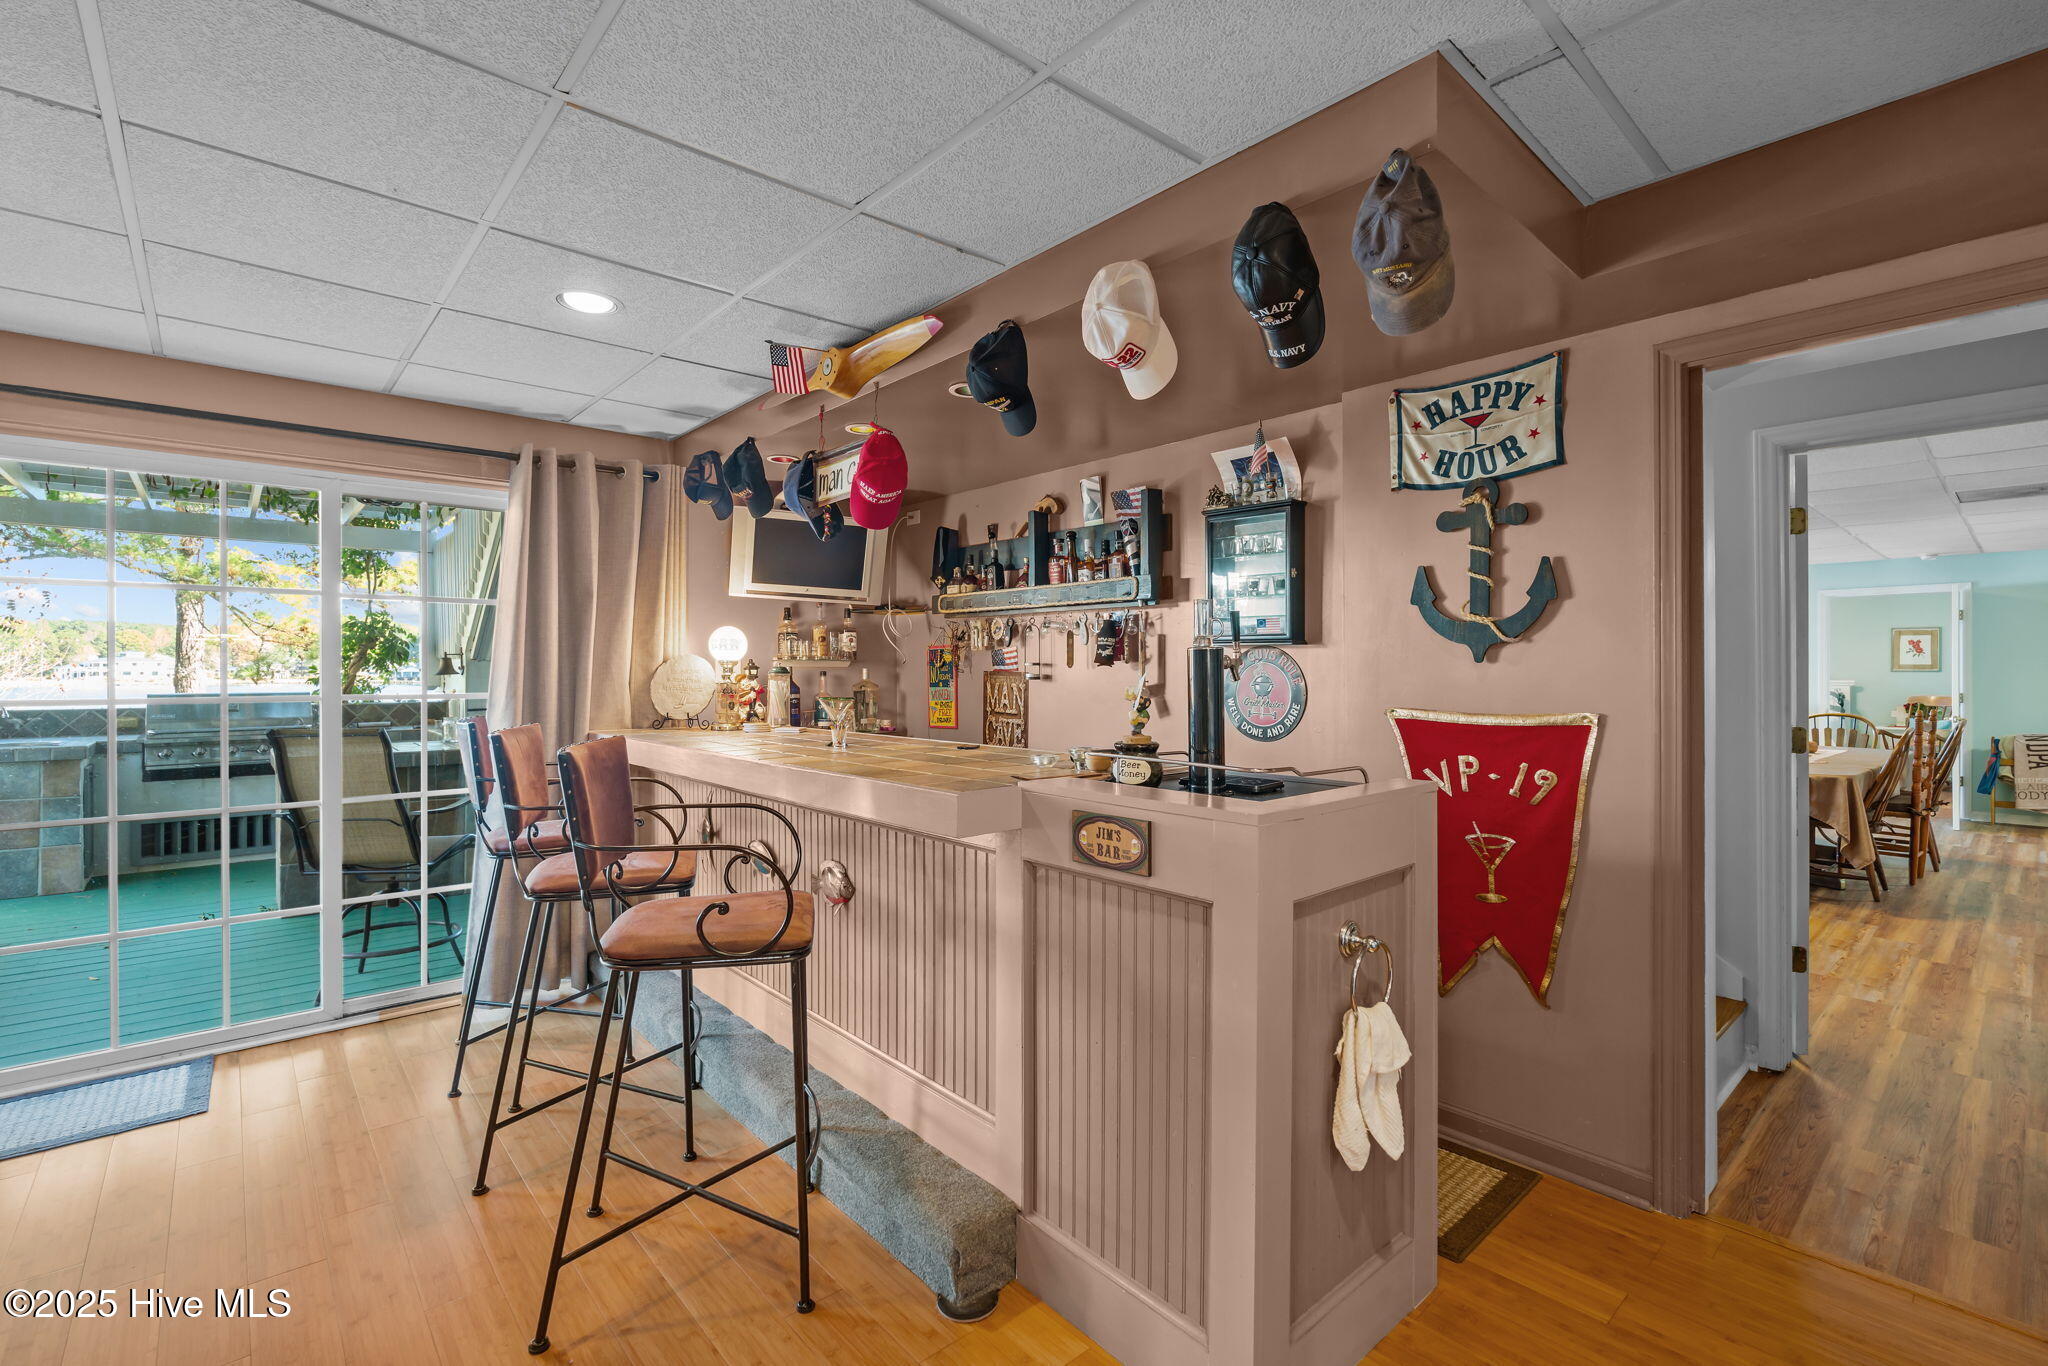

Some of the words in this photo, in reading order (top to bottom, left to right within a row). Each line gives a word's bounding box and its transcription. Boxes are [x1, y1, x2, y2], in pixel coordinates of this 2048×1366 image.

[1258, 302, 1296, 317] NAVY
[1280, 344, 1306, 358] NAVY
[1421, 380, 1535, 431] HAPPY
[1431, 435, 1528, 480] HOUR
[818, 468, 843, 497] man
[1247, 648, 1277, 662] GUYS
[1277, 655, 1303, 686] RULE
[986, 680, 1026, 719] MAN
[986, 714, 1026, 747] CAVE
[1227, 697, 1241, 723] WELL
[1241, 721, 1264, 738] DONE
[1267, 724, 1285, 738] AND
[1284, 702, 1301, 727] RARE
[1121, 760, 1141, 769] Beer
[1096, 826, 1121, 842] JIM'S
[1097, 843, 1120, 860] BAR
